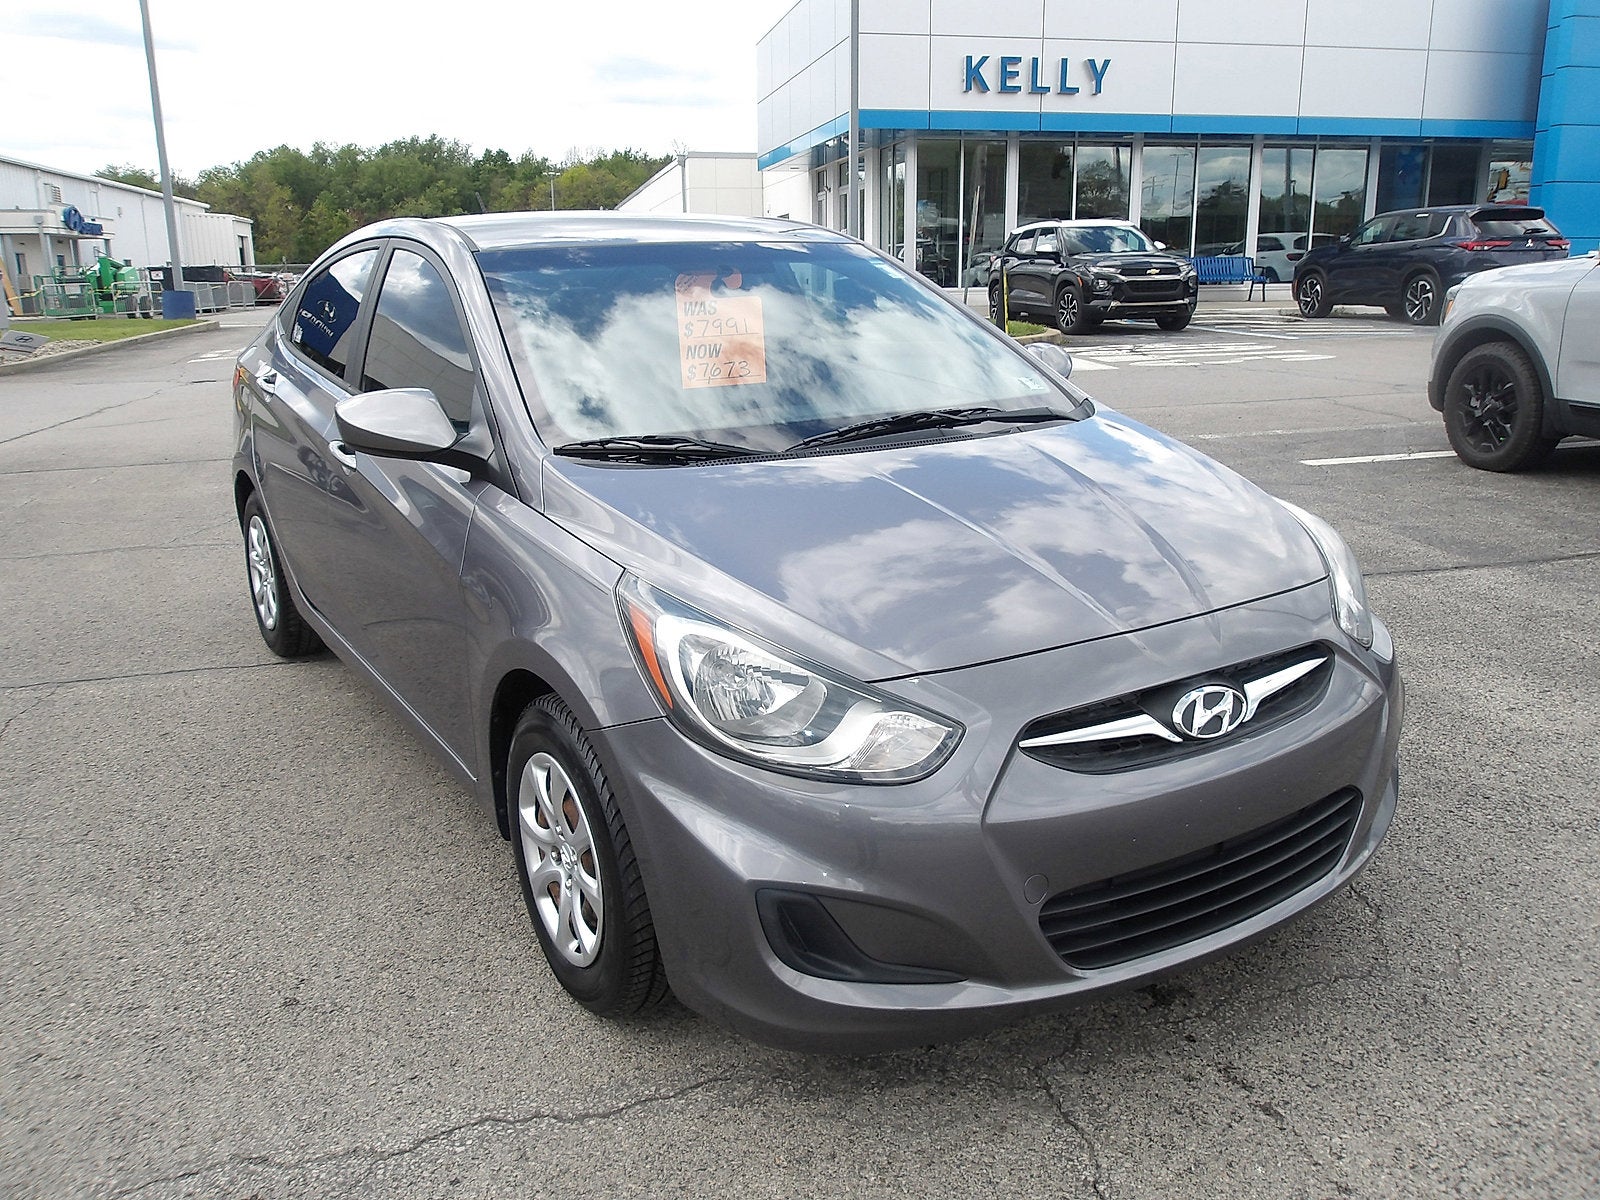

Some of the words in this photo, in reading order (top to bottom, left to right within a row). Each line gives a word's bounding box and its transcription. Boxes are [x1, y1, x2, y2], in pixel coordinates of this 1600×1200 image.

[963, 55, 1112, 95] KELLY
[683, 301, 717, 316] WAS
[686, 343, 722, 360] NOW
